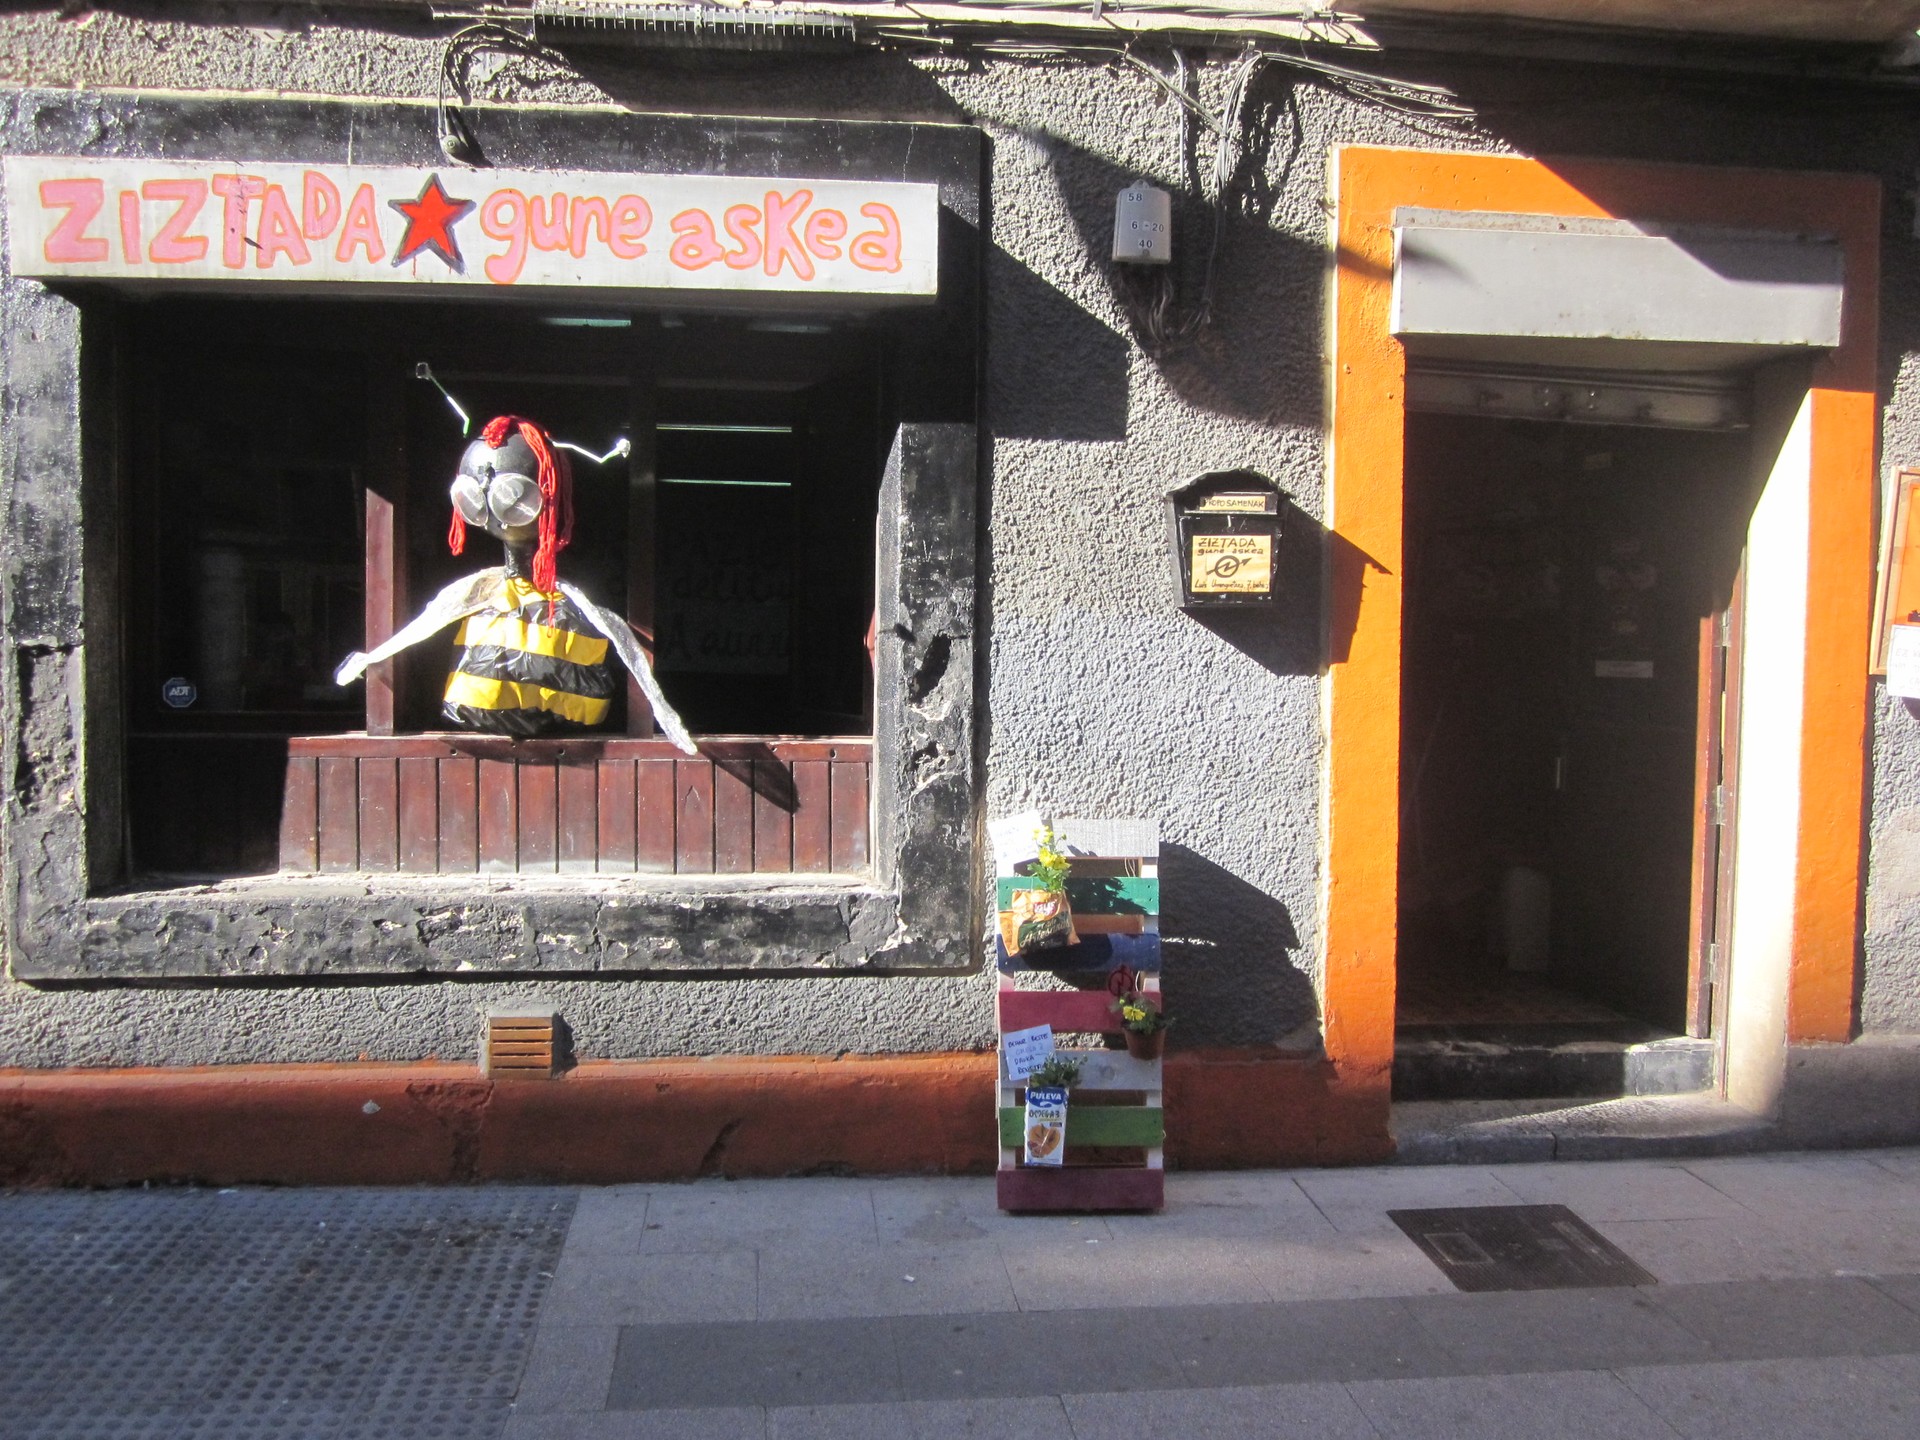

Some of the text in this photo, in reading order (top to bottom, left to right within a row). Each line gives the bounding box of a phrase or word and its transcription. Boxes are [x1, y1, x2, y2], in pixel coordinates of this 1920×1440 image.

[1128, 192, 1143, 202] 58
[40, 170, 386, 269] ZIZTADA
[479, 188, 653, 285] gune
[1139, 239, 1153, 249] 40
[1198, 537, 1256, 548] ZIZTADA
[1197, 548, 1225, 556] gune
[169, 686, 191, 697] ADT
[1030, 1091, 1062, 1100] PULEVA
